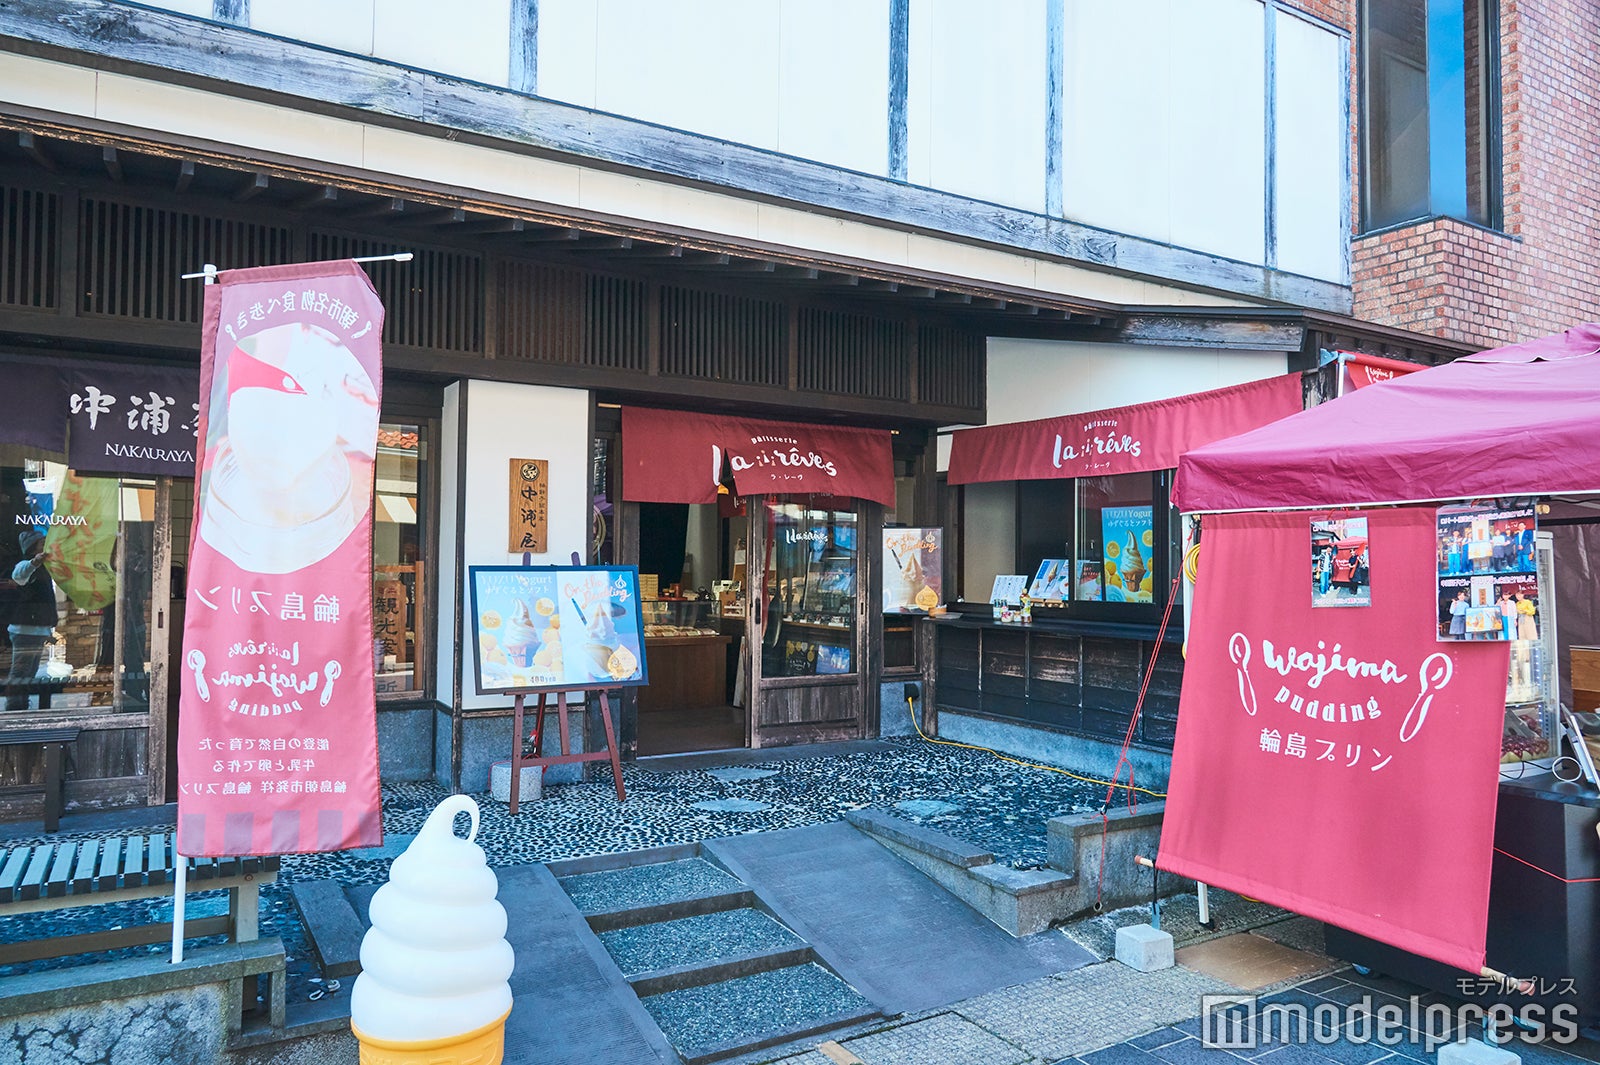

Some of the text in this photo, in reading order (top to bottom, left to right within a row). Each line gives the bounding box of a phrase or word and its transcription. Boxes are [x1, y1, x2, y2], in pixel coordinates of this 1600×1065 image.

[105, 443, 194, 463] NAKAURAYA
[15, 513, 88, 526] NAKAURAYA
[520, 486, 538, 548] 中浦屋
[1128, 510, 1152, 519] Yogur
[1273, 685, 1382, 723] pudding
[1259, 727, 1393, 773] 輪島プリン
